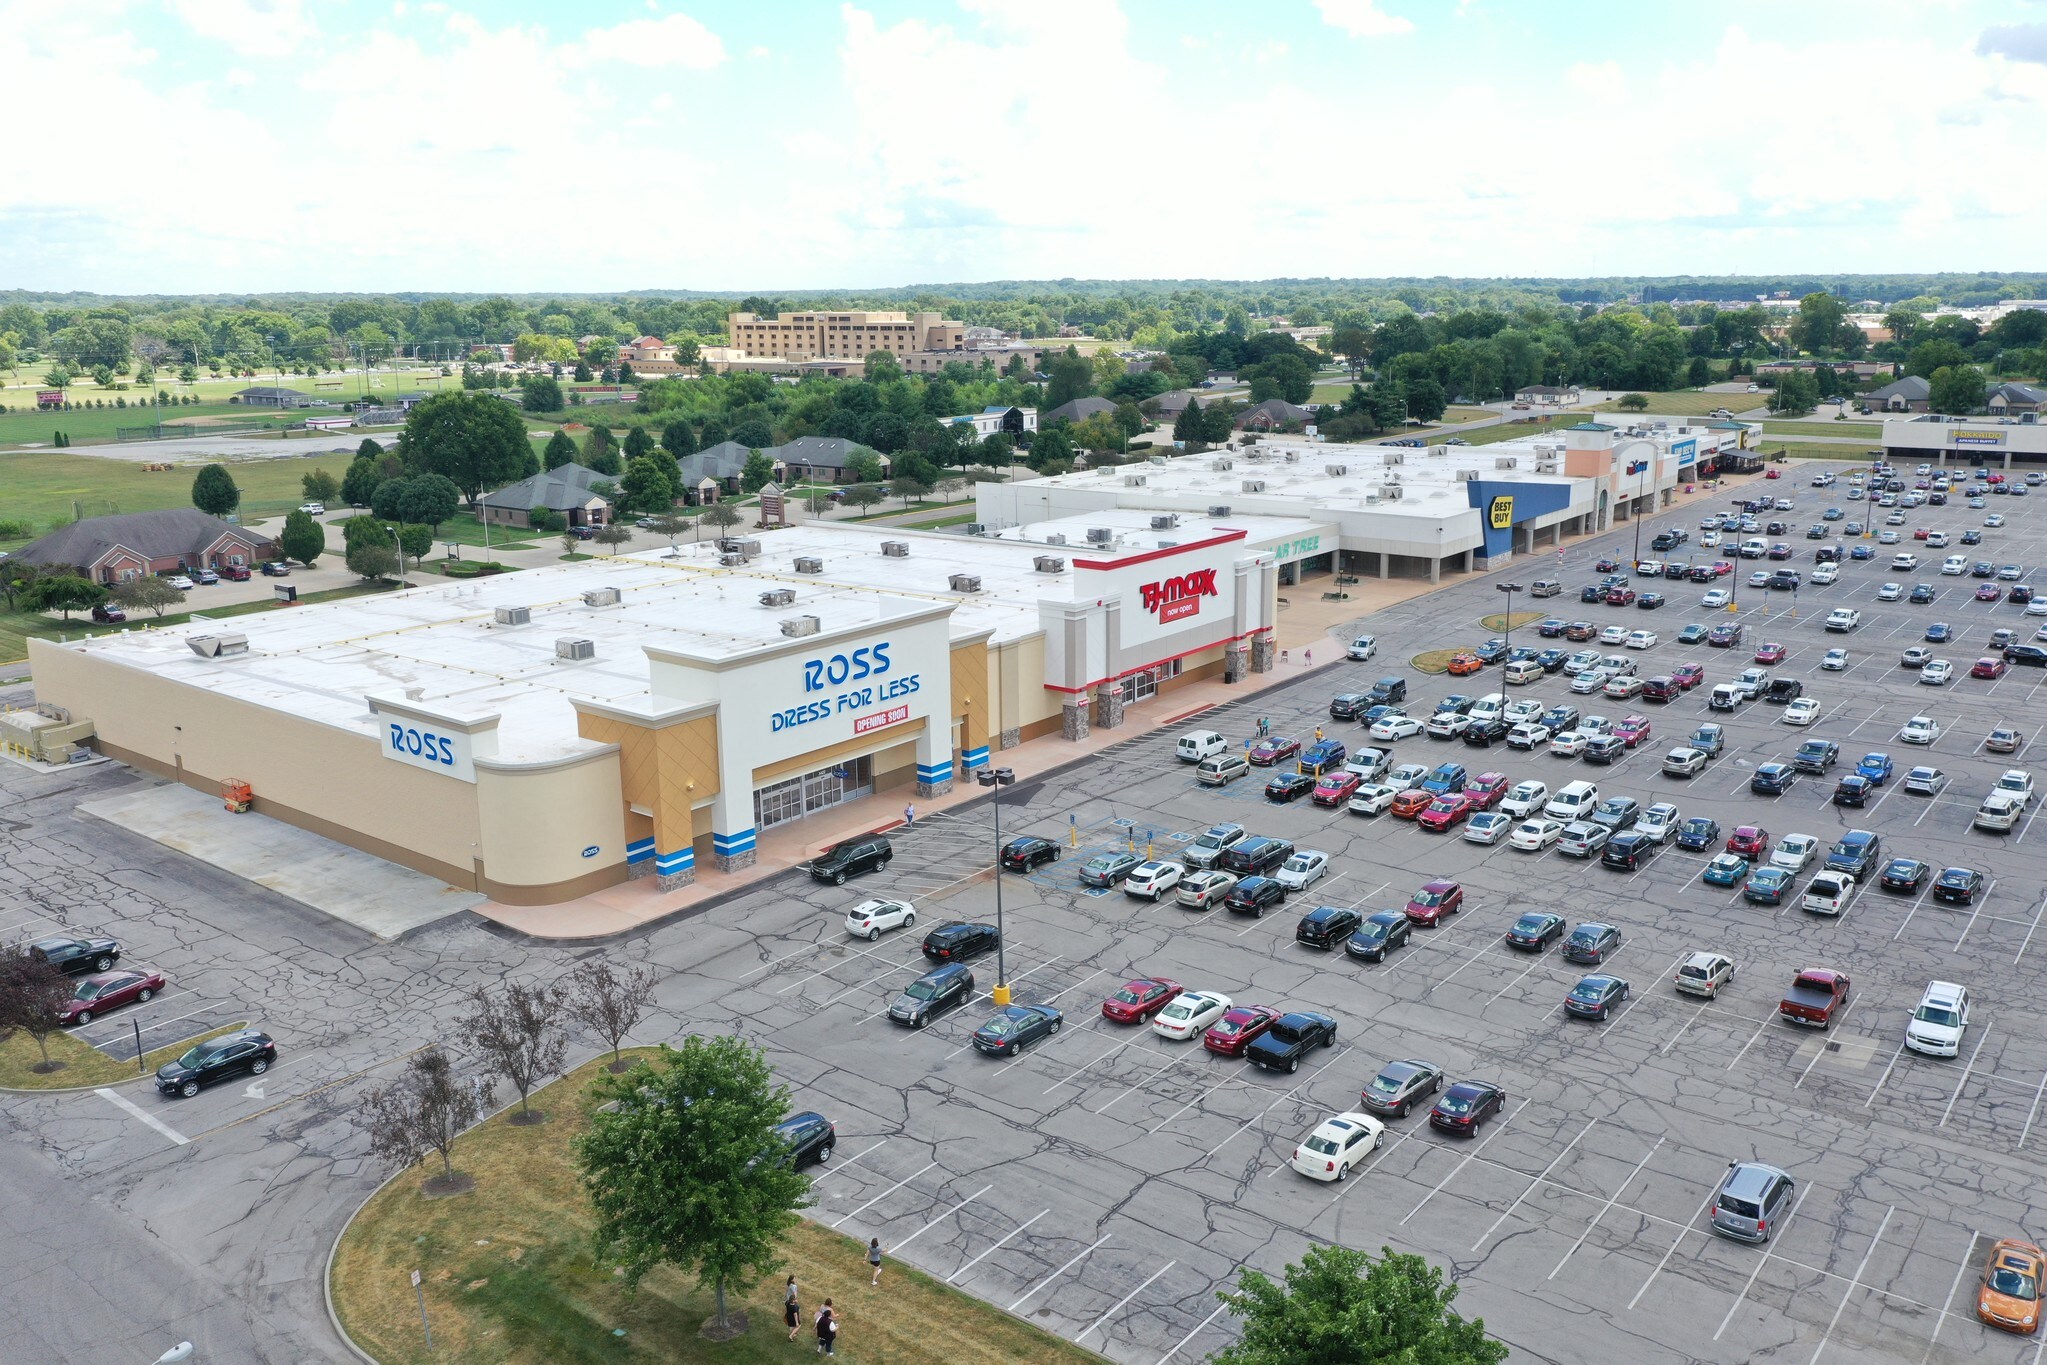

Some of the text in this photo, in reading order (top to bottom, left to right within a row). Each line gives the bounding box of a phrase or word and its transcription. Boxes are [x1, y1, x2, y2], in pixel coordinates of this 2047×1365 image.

[1494, 501, 1511, 511] BEST
[1494, 513, 1509, 523] BUY
[1292, 535, 1320, 556] TREE
[1167, 603, 1193, 617] now open
[804, 641, 890, 692] ROSS
[771, 674, 920, 732] DRESS FOR LESS
[857, 704, 906, 732] OPENING SOON
[390, 723, 455, 766] ROSS
[583, 847, 598, 856] ROSS
